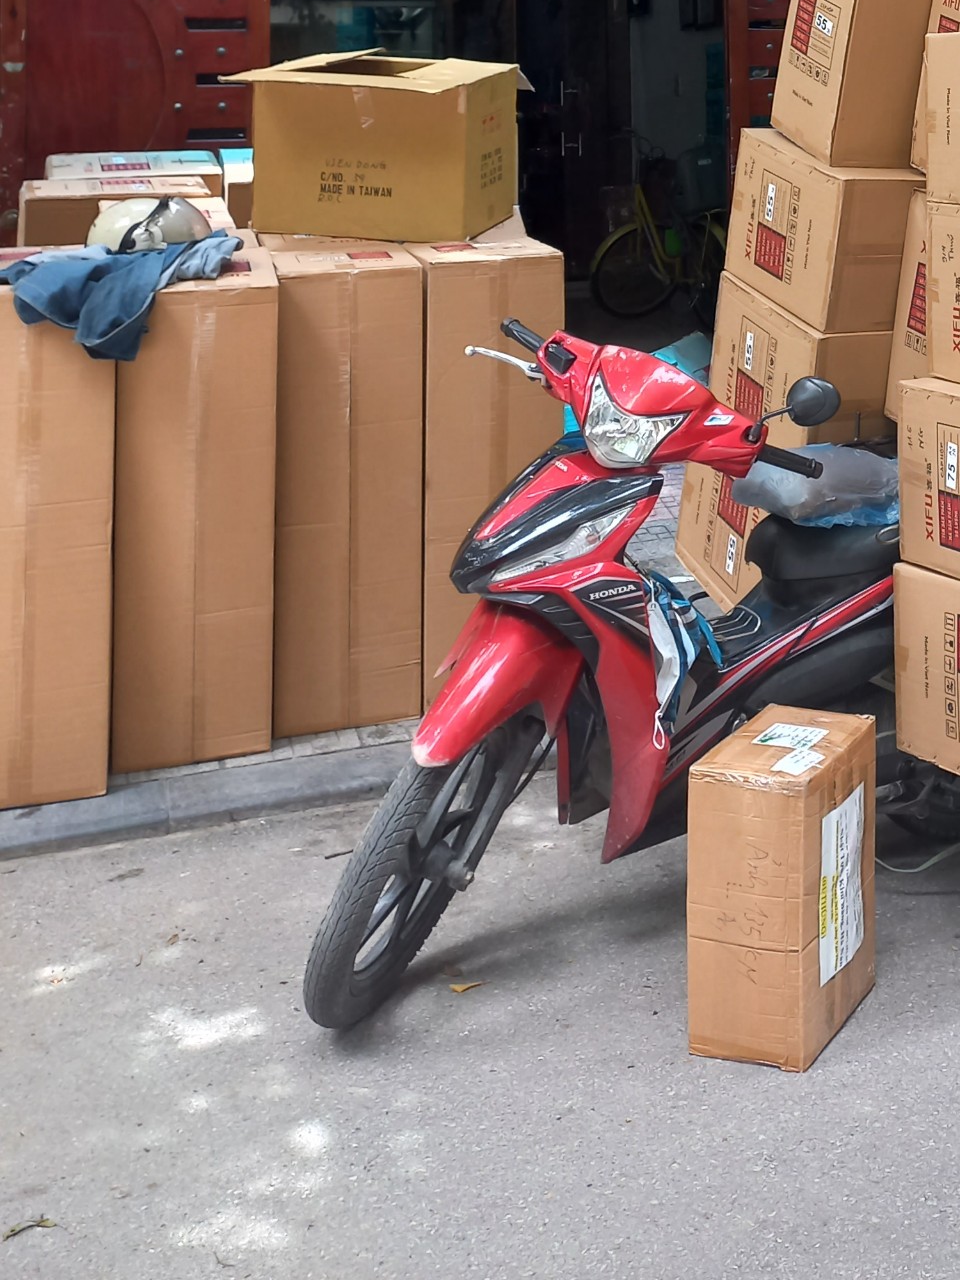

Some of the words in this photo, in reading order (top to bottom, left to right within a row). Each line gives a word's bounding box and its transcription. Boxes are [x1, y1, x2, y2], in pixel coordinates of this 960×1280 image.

[816, 15, 827, 31] 55
[320, 183, 343, 194] MADE
[347, 185, 355, 195] IN
[359, 185, 392, 197] TAIWAN
[953, 306, 960, 353] XIFU
[948, 463, 956, 481] 75
[925, 494, 934, 542] XIFU
[589, 584, 637, 600] HONDA
